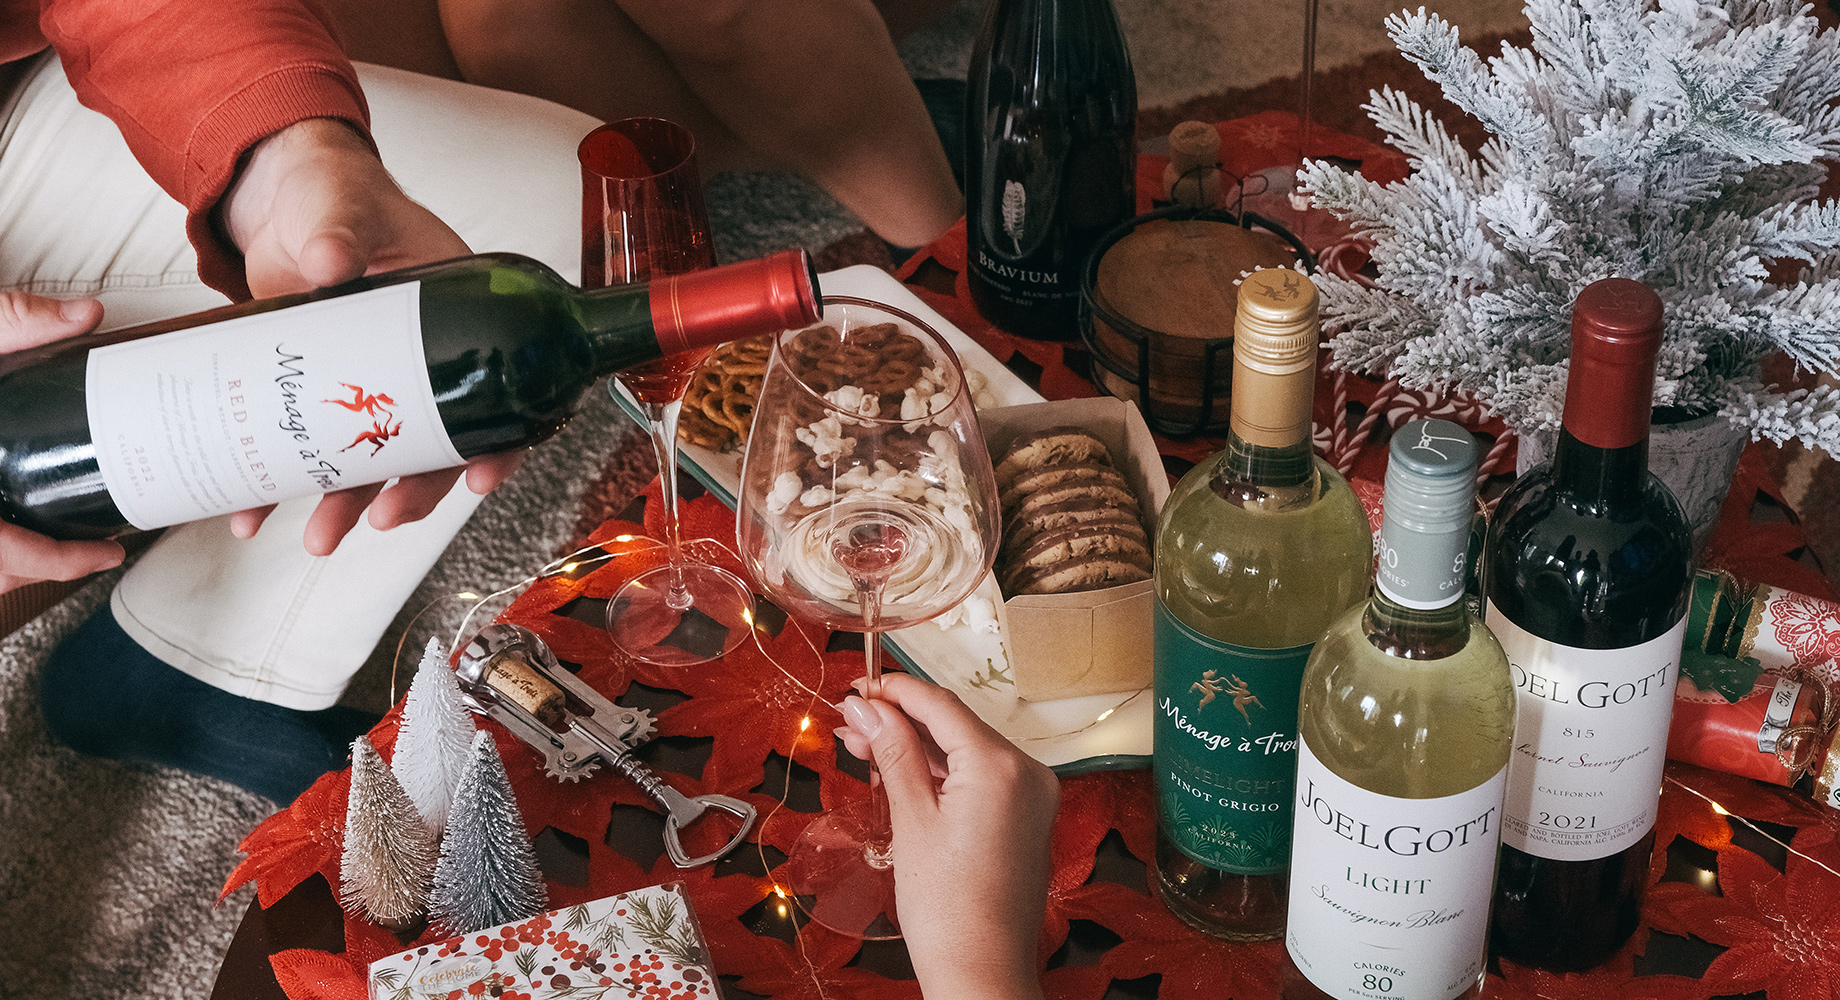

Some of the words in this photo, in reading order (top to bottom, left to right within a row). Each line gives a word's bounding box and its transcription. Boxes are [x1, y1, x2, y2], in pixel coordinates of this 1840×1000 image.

[980, 251, 1058, 284] BRAVIUM
[275, 341, 310, 443] Ménage
[299, 449, 320, 460] à
[228, 380, 247, 423] RED
[240, 436, 276, 491] BLEND
[1511, 662, 1569, 704] OEL
[1159, 697, 1231, 751] Ménage
[1237, 736, 1251, 752] à
[1562, 727, 1595, 739] 815
[1516, 743, 1564, 764] bernet
[1568, 746, 1649, 773] Sauvignon
[1171, 771, 1212, 802] PINOT
[1219, 798, 1279, 812] GRIGIO
[1538, 785, 1604, 798] CALIFORNIA
[1539, 811, 1596, 829] 2021
[1188, 827, 1252, 850] CALIFORNIA
[1202, 824, 1236, 839] 2023
[1550, 832, 1582, 840] BOTTLED
[1551, 838, 1592, 846] CALIFORNIA
[1346, 866, 1431, 895] LIGHT
[1311, 884, 1402, 928] Sauvignon
[1405, 908, 1464, 929] Blanc
[420, 964, 475, 985] Celebrate
[449, 970, 481, 985] HOME
[1353, 961, 1406, 977] CALORIES
[1362, 973, 1393, 993] 80
